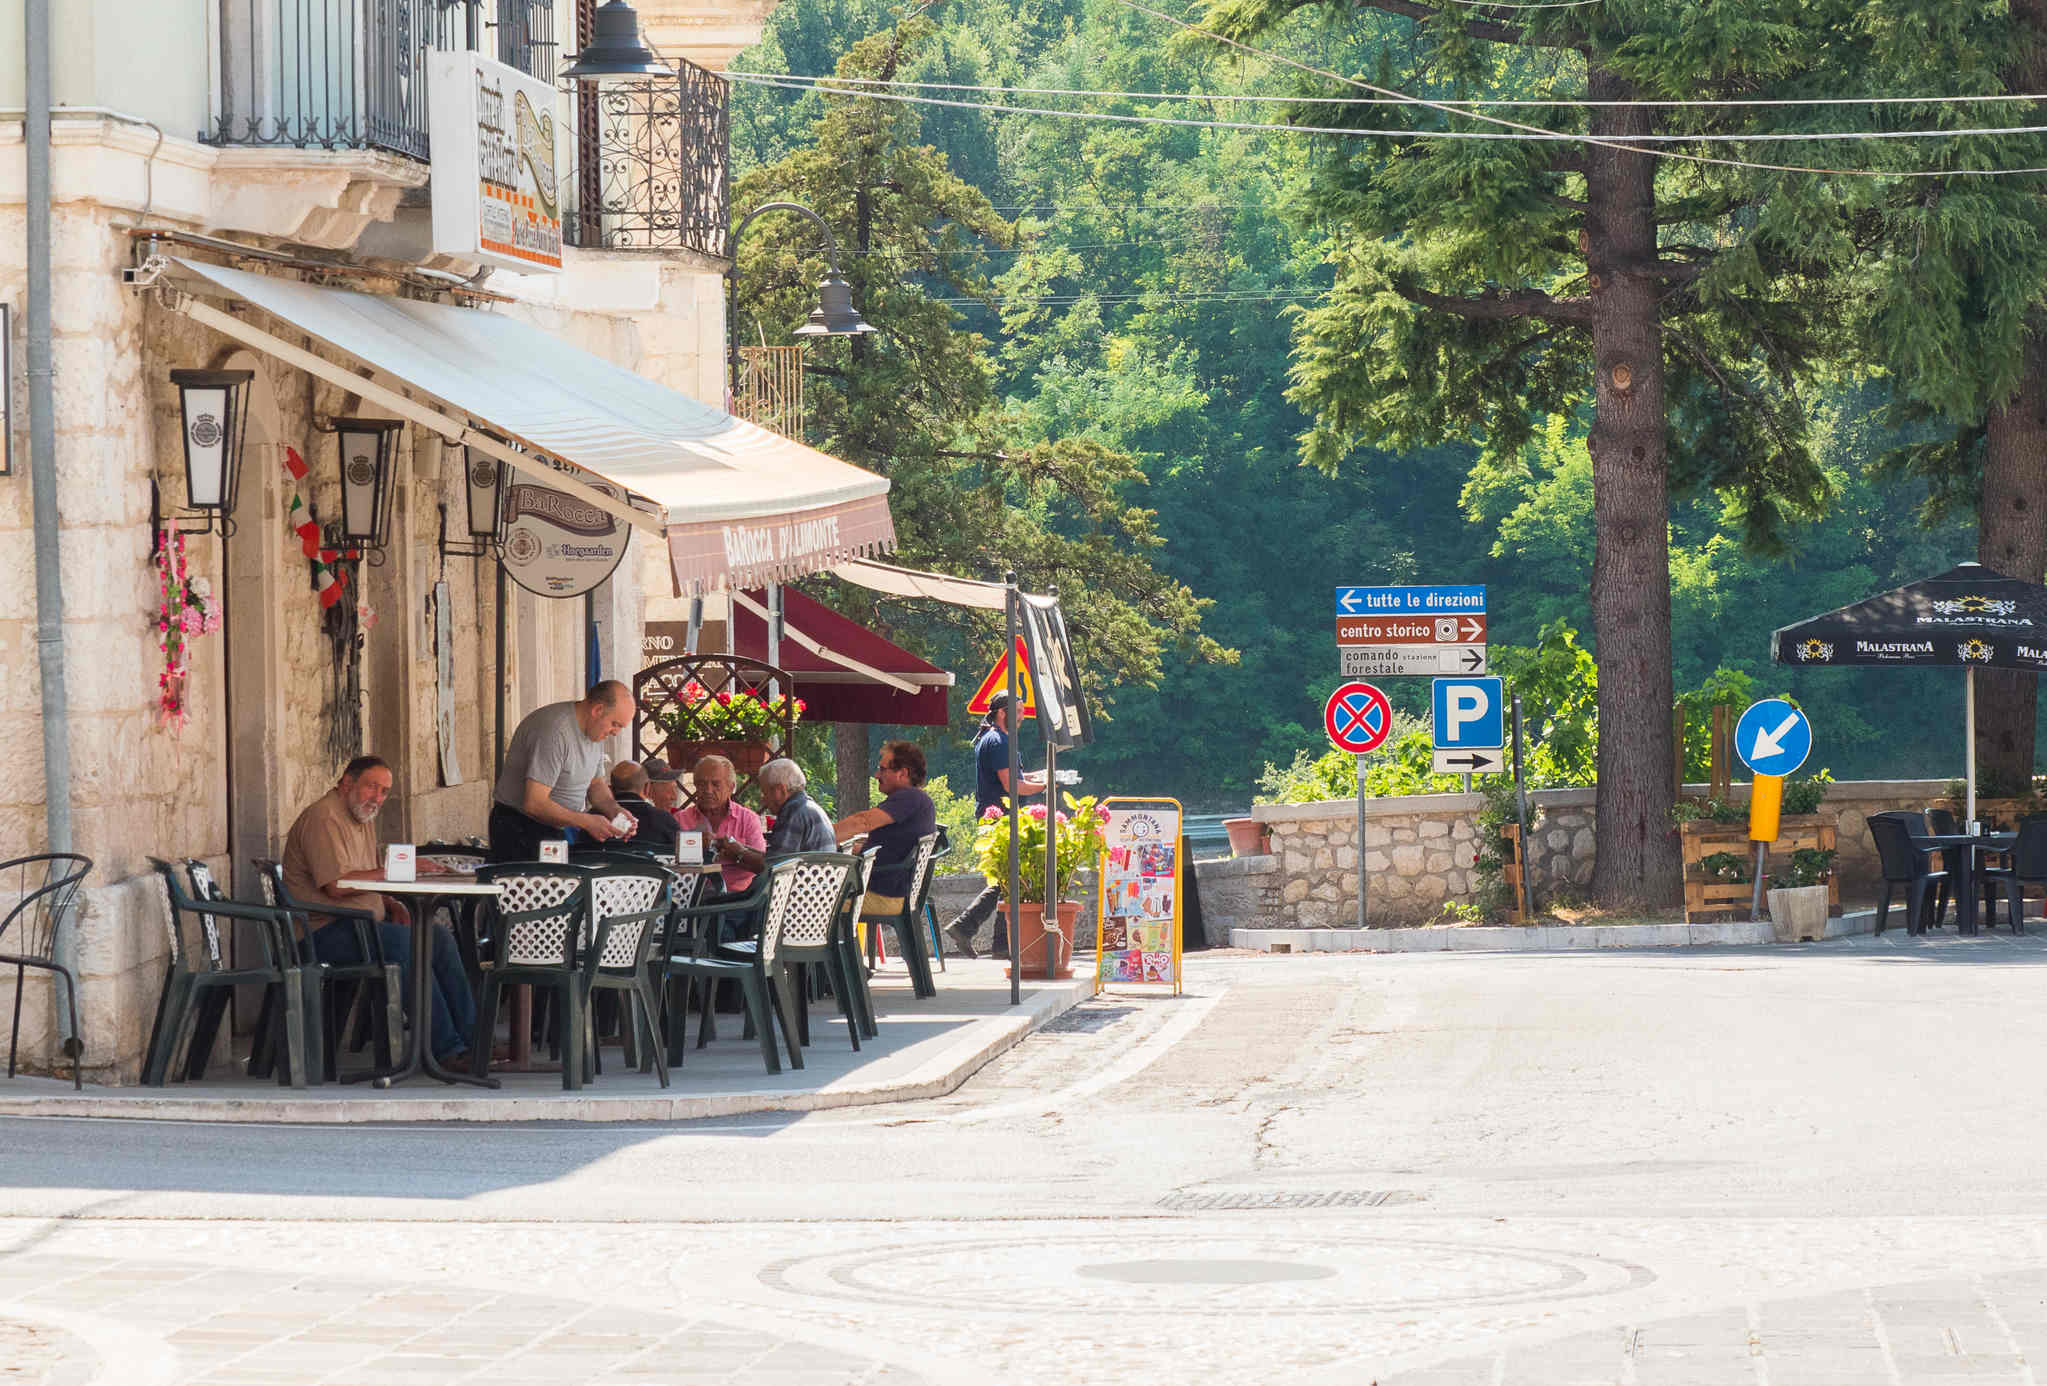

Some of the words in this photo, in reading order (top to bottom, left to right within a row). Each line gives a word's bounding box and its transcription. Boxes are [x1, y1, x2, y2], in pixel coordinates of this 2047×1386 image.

[1367, 593, 1401, 607] tutte
[1407, 592, 1420, 607] le
[1426, 592, 1484, 607] direzioni
[1340, 623, 1382, 638] centro
[1386, 622, 1430, 637] storico
[1345, 649, 1399, 661] comando
[1346, 662, 1404, 674] forestale
[1446, 685, 1489, 742] P
